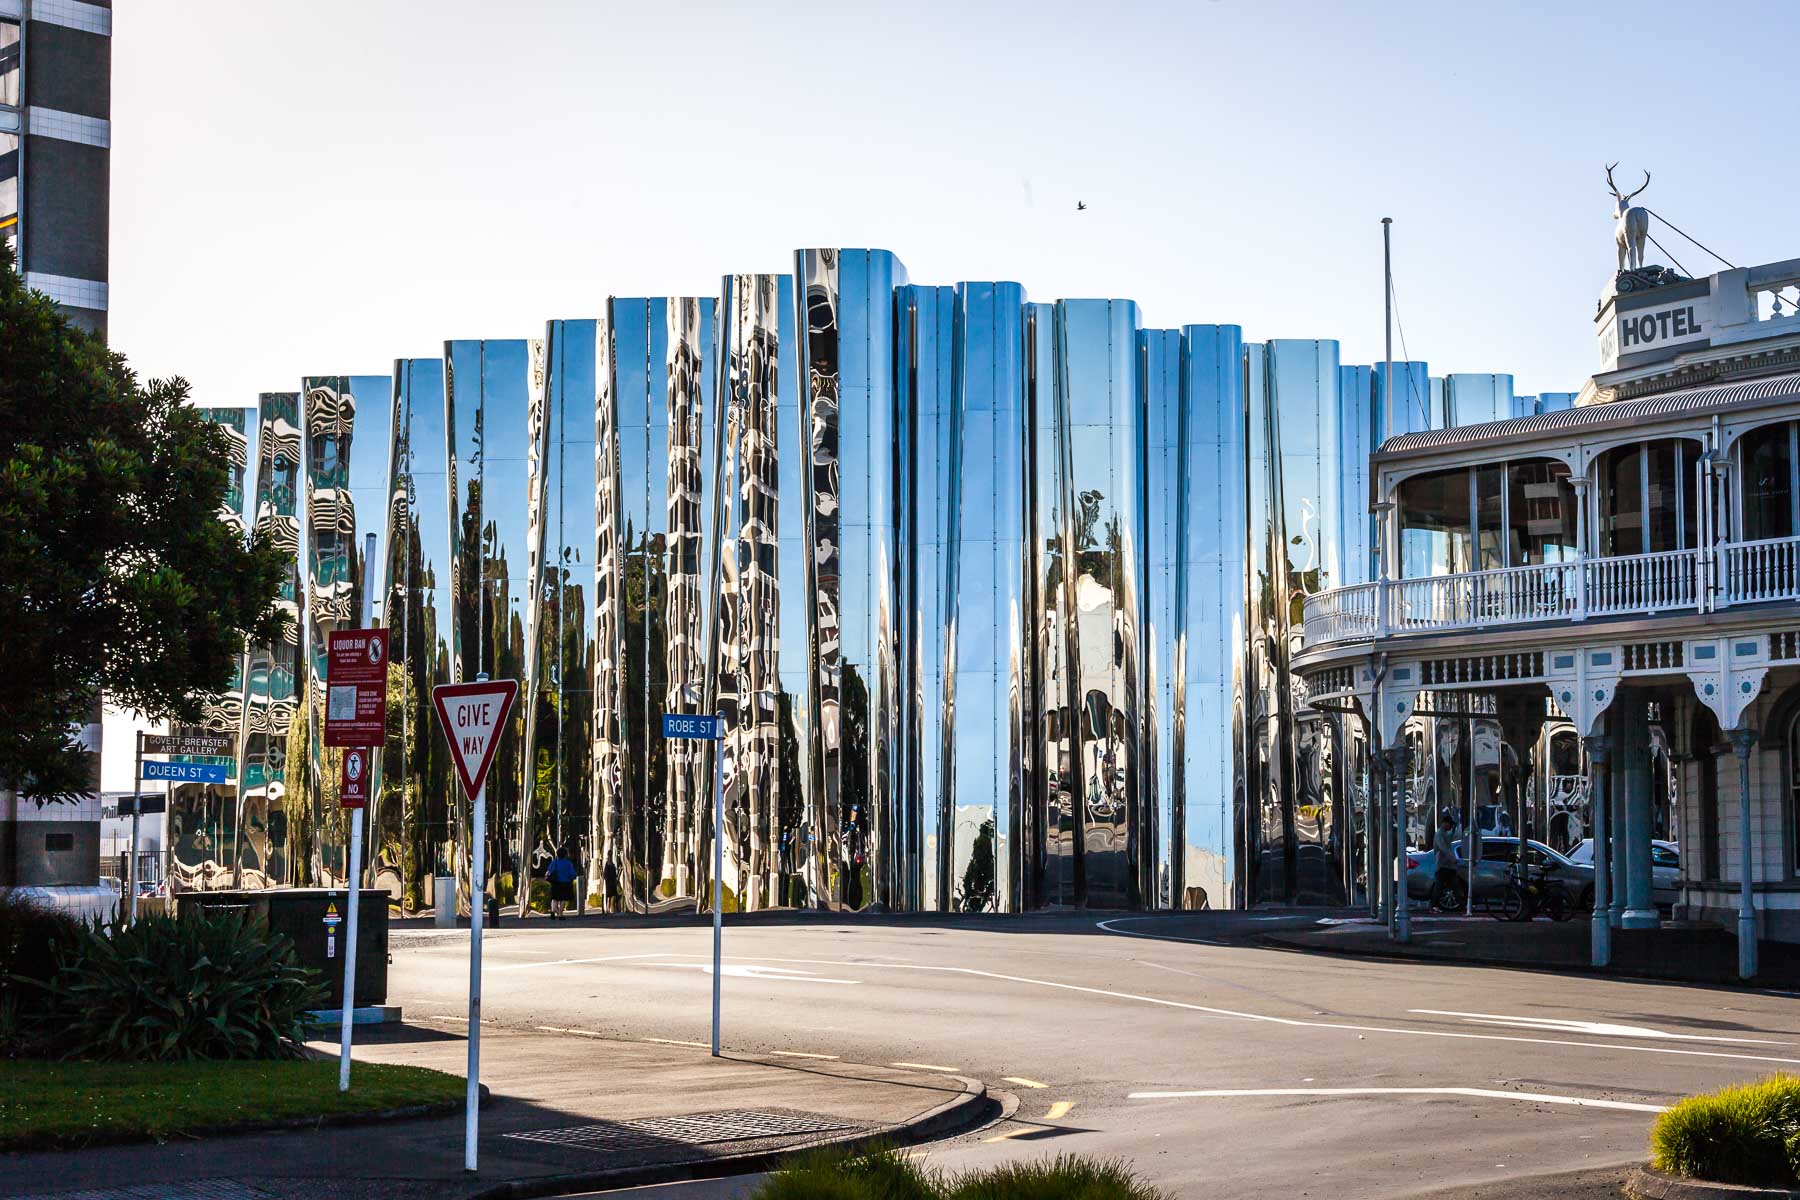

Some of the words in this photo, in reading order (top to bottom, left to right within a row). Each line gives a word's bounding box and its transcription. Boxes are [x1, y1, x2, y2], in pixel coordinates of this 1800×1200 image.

[1622, 306, 1702, 347] HOTEL
[333, 639, 354, 651] LIQUOR
[354, 638, 366, 649] BAN
[457, 703, 491, 727] GIVE
[668, 719, 695, 733] ROBE
[699, 720, 712, 734] ST
[149, 735, 228, 747] GOVETT-BREWSTER
[463, 735, 485, 755] WAY
[160, 745, 176, 753] ART
[180, 746, 218, 755] GALLERY
[148, 764, 186, 777] QUEEN
[189, 767, 203, 778] ST
[347, 783, 359, 794] NO
